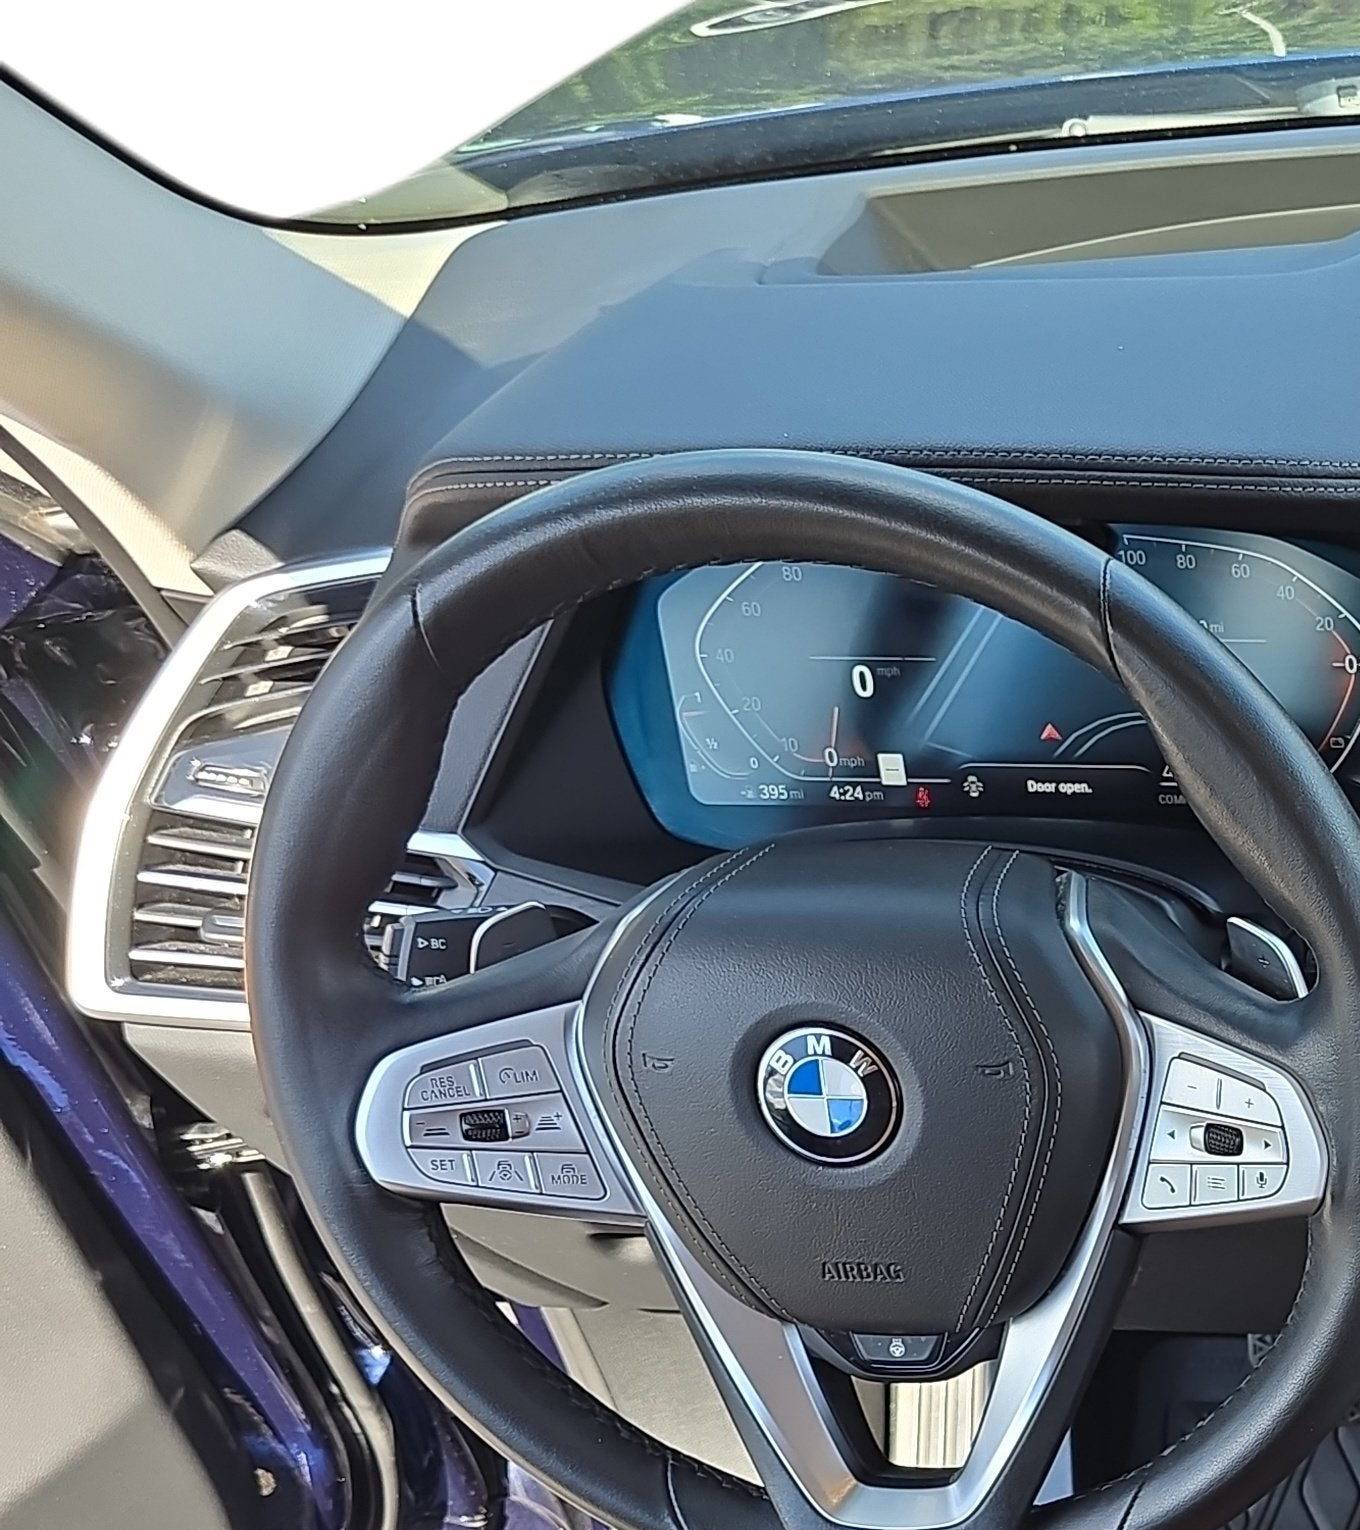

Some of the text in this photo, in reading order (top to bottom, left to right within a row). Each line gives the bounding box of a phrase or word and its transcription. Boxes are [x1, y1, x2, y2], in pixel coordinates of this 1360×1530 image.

[1119, 550, 1146, 565] 100
[1176, 555, 1195, 569] 80
[782, 566, 802, 582] 80
[1232, 563, 1250, 578] 60
[1276, 585, 1295, 600] 40
[742, 602, 761, 616] 60
[1315, 616, 1334, 631] 20
[715, 649, 734, 663] 40
[1344, 653, 1357, 673] 0
[852, 664, 900, 698] 0 mph
[742, 697, 761, 711] 20
[781, 738, 798, 752] 10
[839, 757, 865, 769] mph
[759, 785, 788, 800] 395
[829, 785, 884, 802] 4:24 pm
[1027, 780, 1093, 795] Door open.
[430, 938, 446, 950] BC
[769, 1035, 878, 1077] BMW
[430, 1075, 455, 1089] RES
[514, 1069, 539, 1083] LIM
[420, 1086, 471, 1102] CANCEL
[430, 1159, 456, 1171] SET
[551, 1173, 588, 1185] MODE
[820, 1261, 905, 1284] AIRBAG
